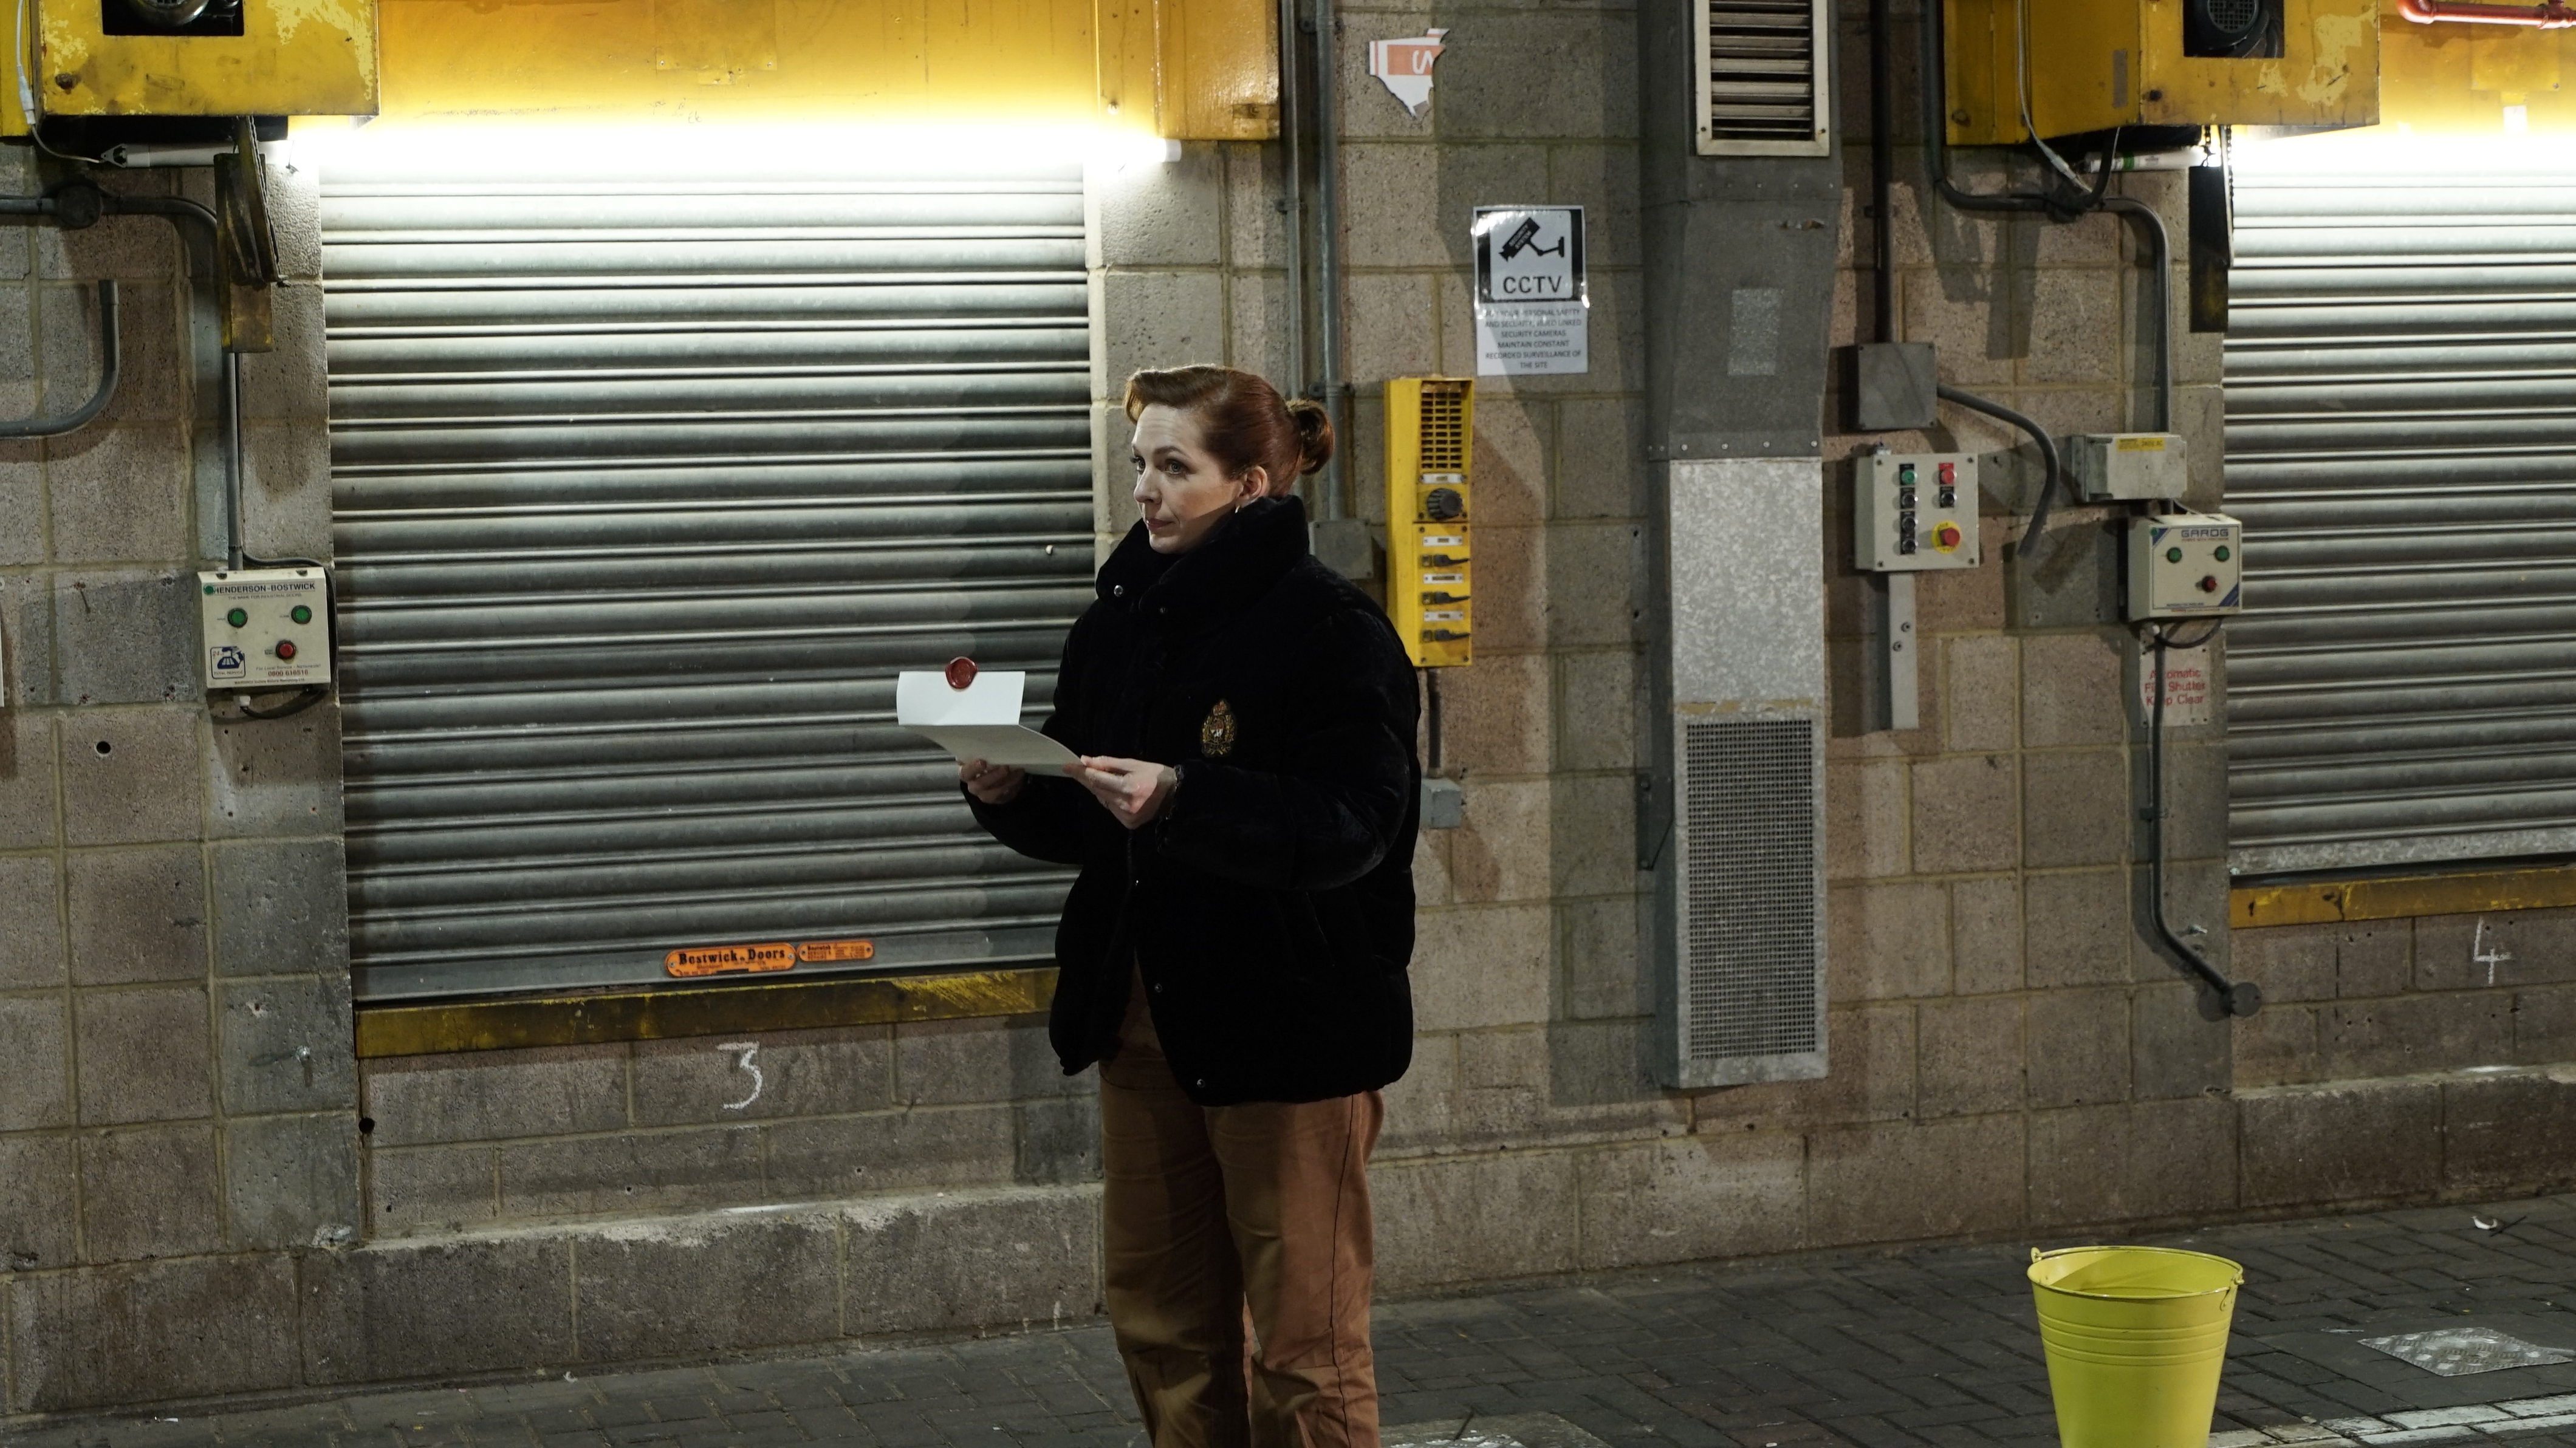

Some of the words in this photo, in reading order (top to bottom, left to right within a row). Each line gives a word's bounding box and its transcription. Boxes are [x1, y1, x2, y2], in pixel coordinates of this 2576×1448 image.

[1503, 276, 1562, 294] CCTV
[2150, 669, 2201, 679] Aomatic
[2168, 681, 2205, 692] Shutter
[2146, 695, 2173, 707] Kp
[2177, 694, 2204, 705] Clear
[748, 948, 785, 960] Doors
[2473, 916, 2512, 985] 4
[717, 1041, 763, 1110] 3
